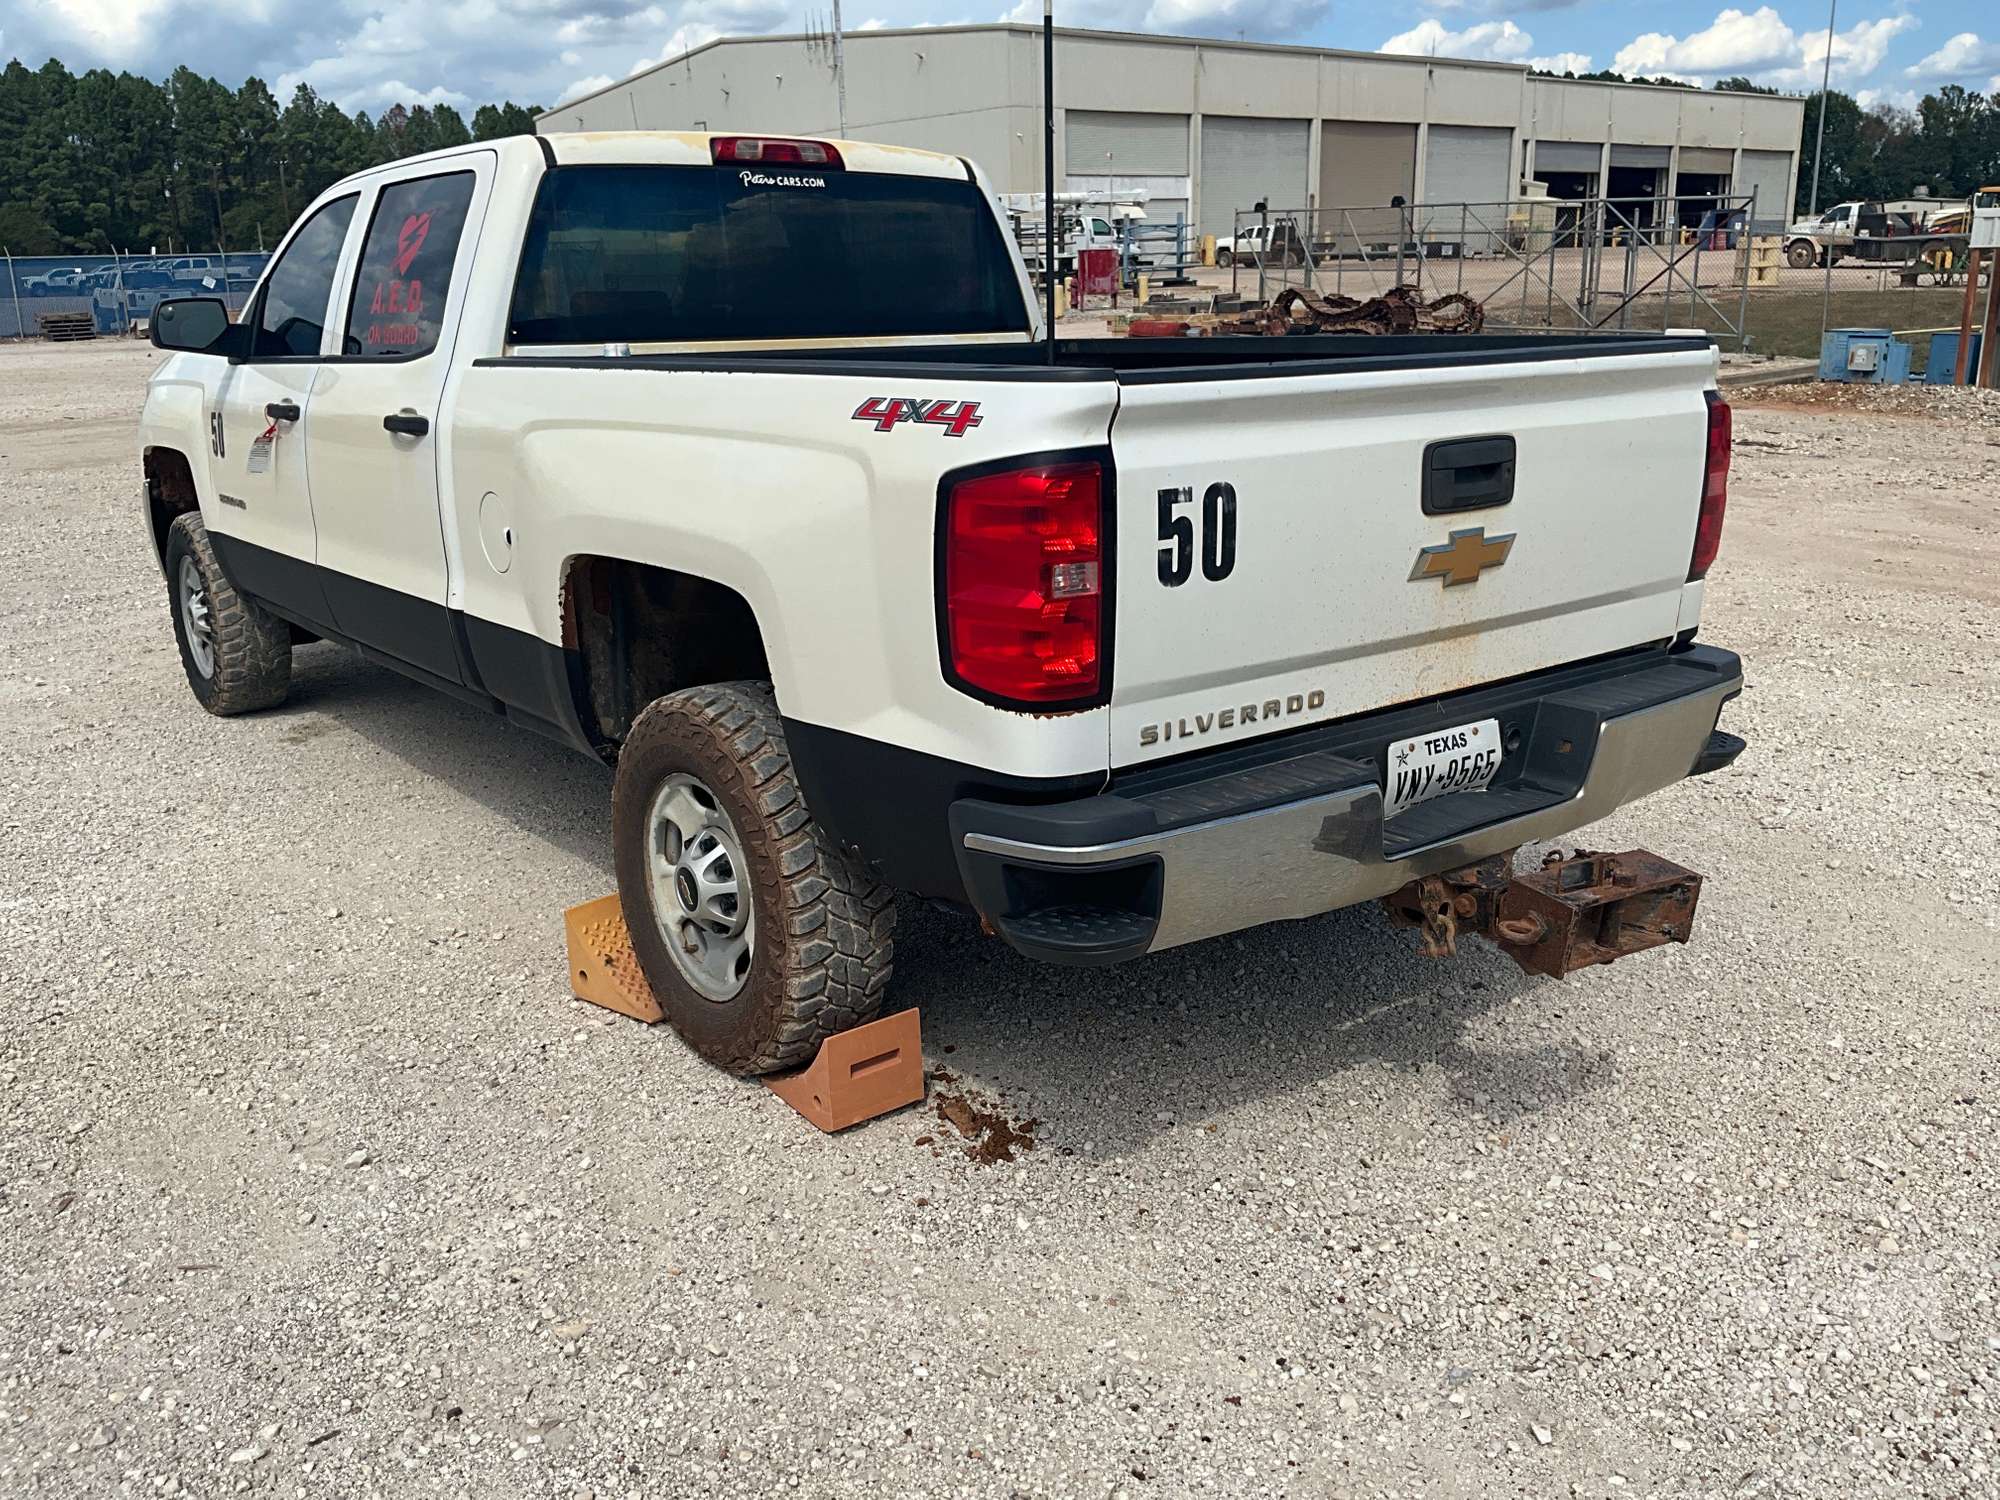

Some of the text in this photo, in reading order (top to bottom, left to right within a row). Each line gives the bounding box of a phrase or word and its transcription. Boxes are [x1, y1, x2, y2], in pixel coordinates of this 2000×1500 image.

[211, 412, 226, 458] 50
[1157, 481, 1237, 588] 50
[1140, 690, 1325, 747] SILVERADO
[1425, 732, 1468, 756] TEXAS
